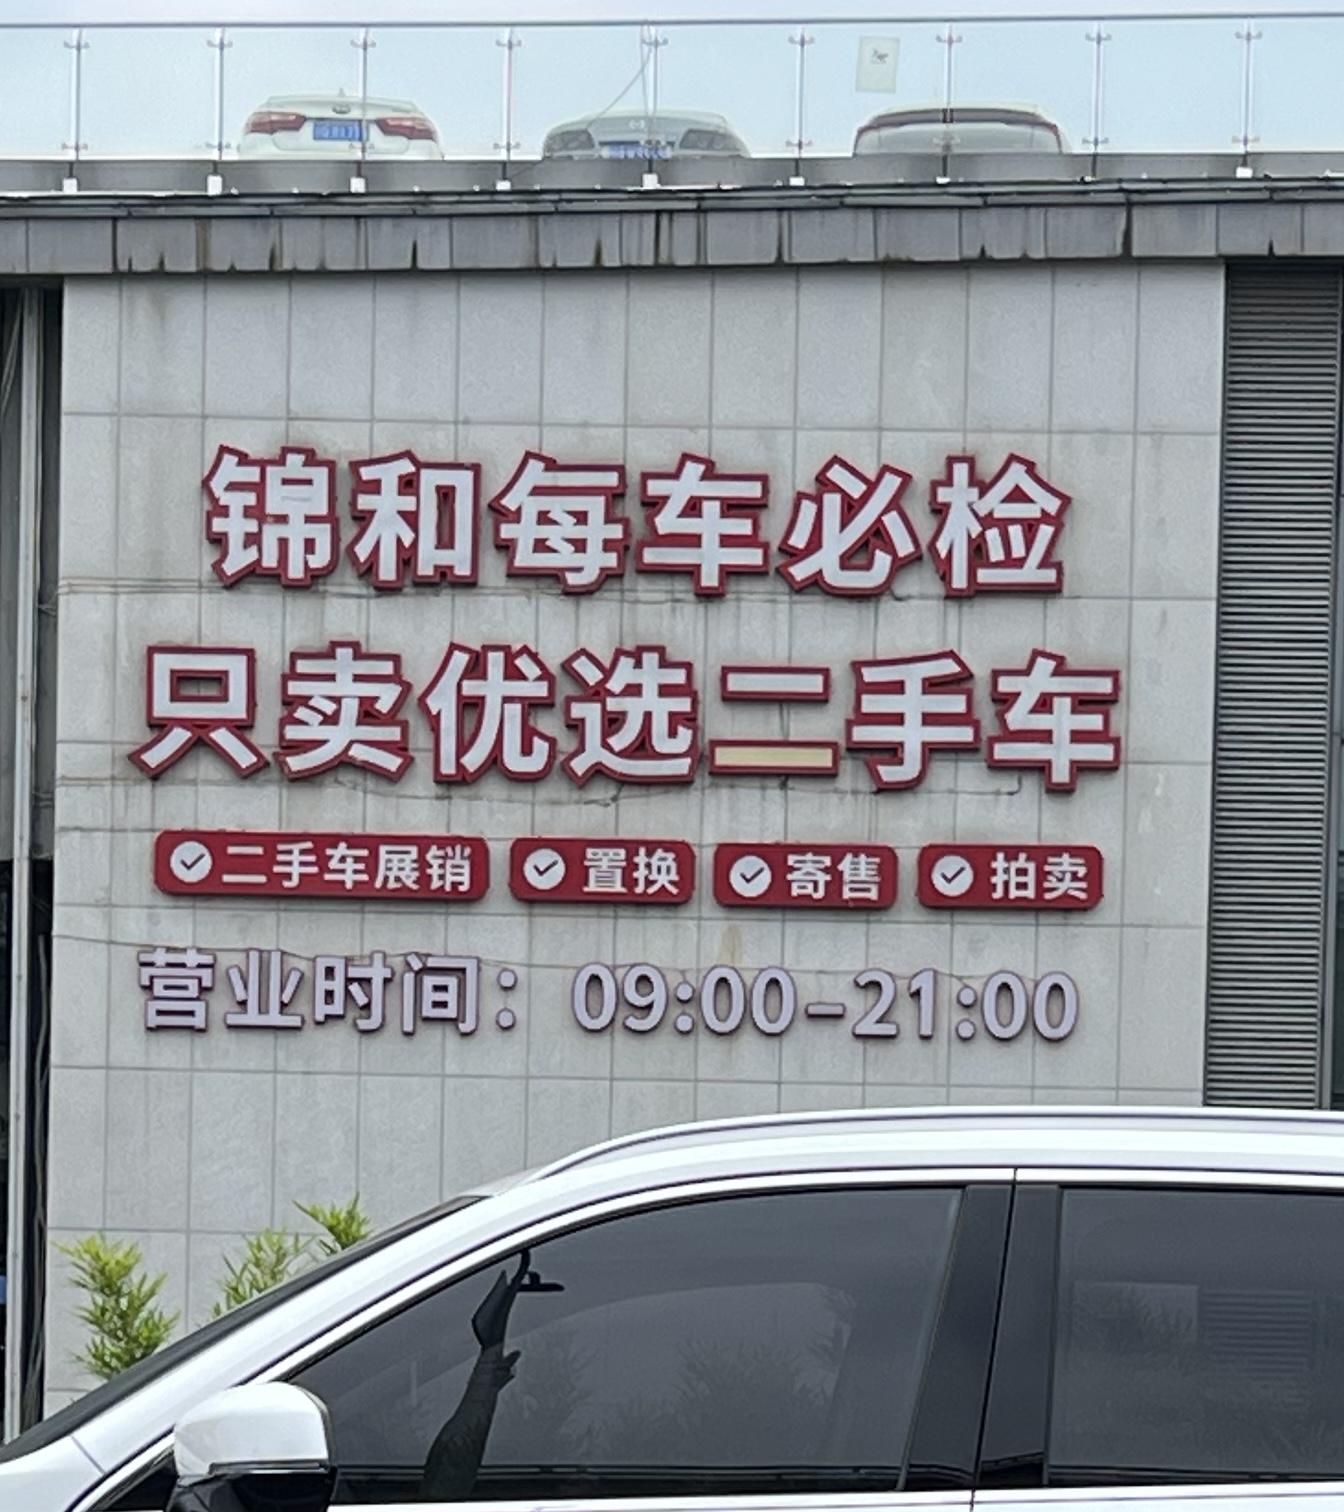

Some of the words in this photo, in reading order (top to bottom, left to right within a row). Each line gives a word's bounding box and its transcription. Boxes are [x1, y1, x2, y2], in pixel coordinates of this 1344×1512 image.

[203, 445, 1071, 595] 锦和每车必检
[130, 640, 1120, 792] 只卖优选二手车
[221, 841, 471, 891] 二手车展销
[583, 847, 680, 895] 置换
[786, 853, 881, 900] 寄售
[991, 852, 1088, 900] 拍卖
[572, 962, 1079, 1041] 09:00-21:00
